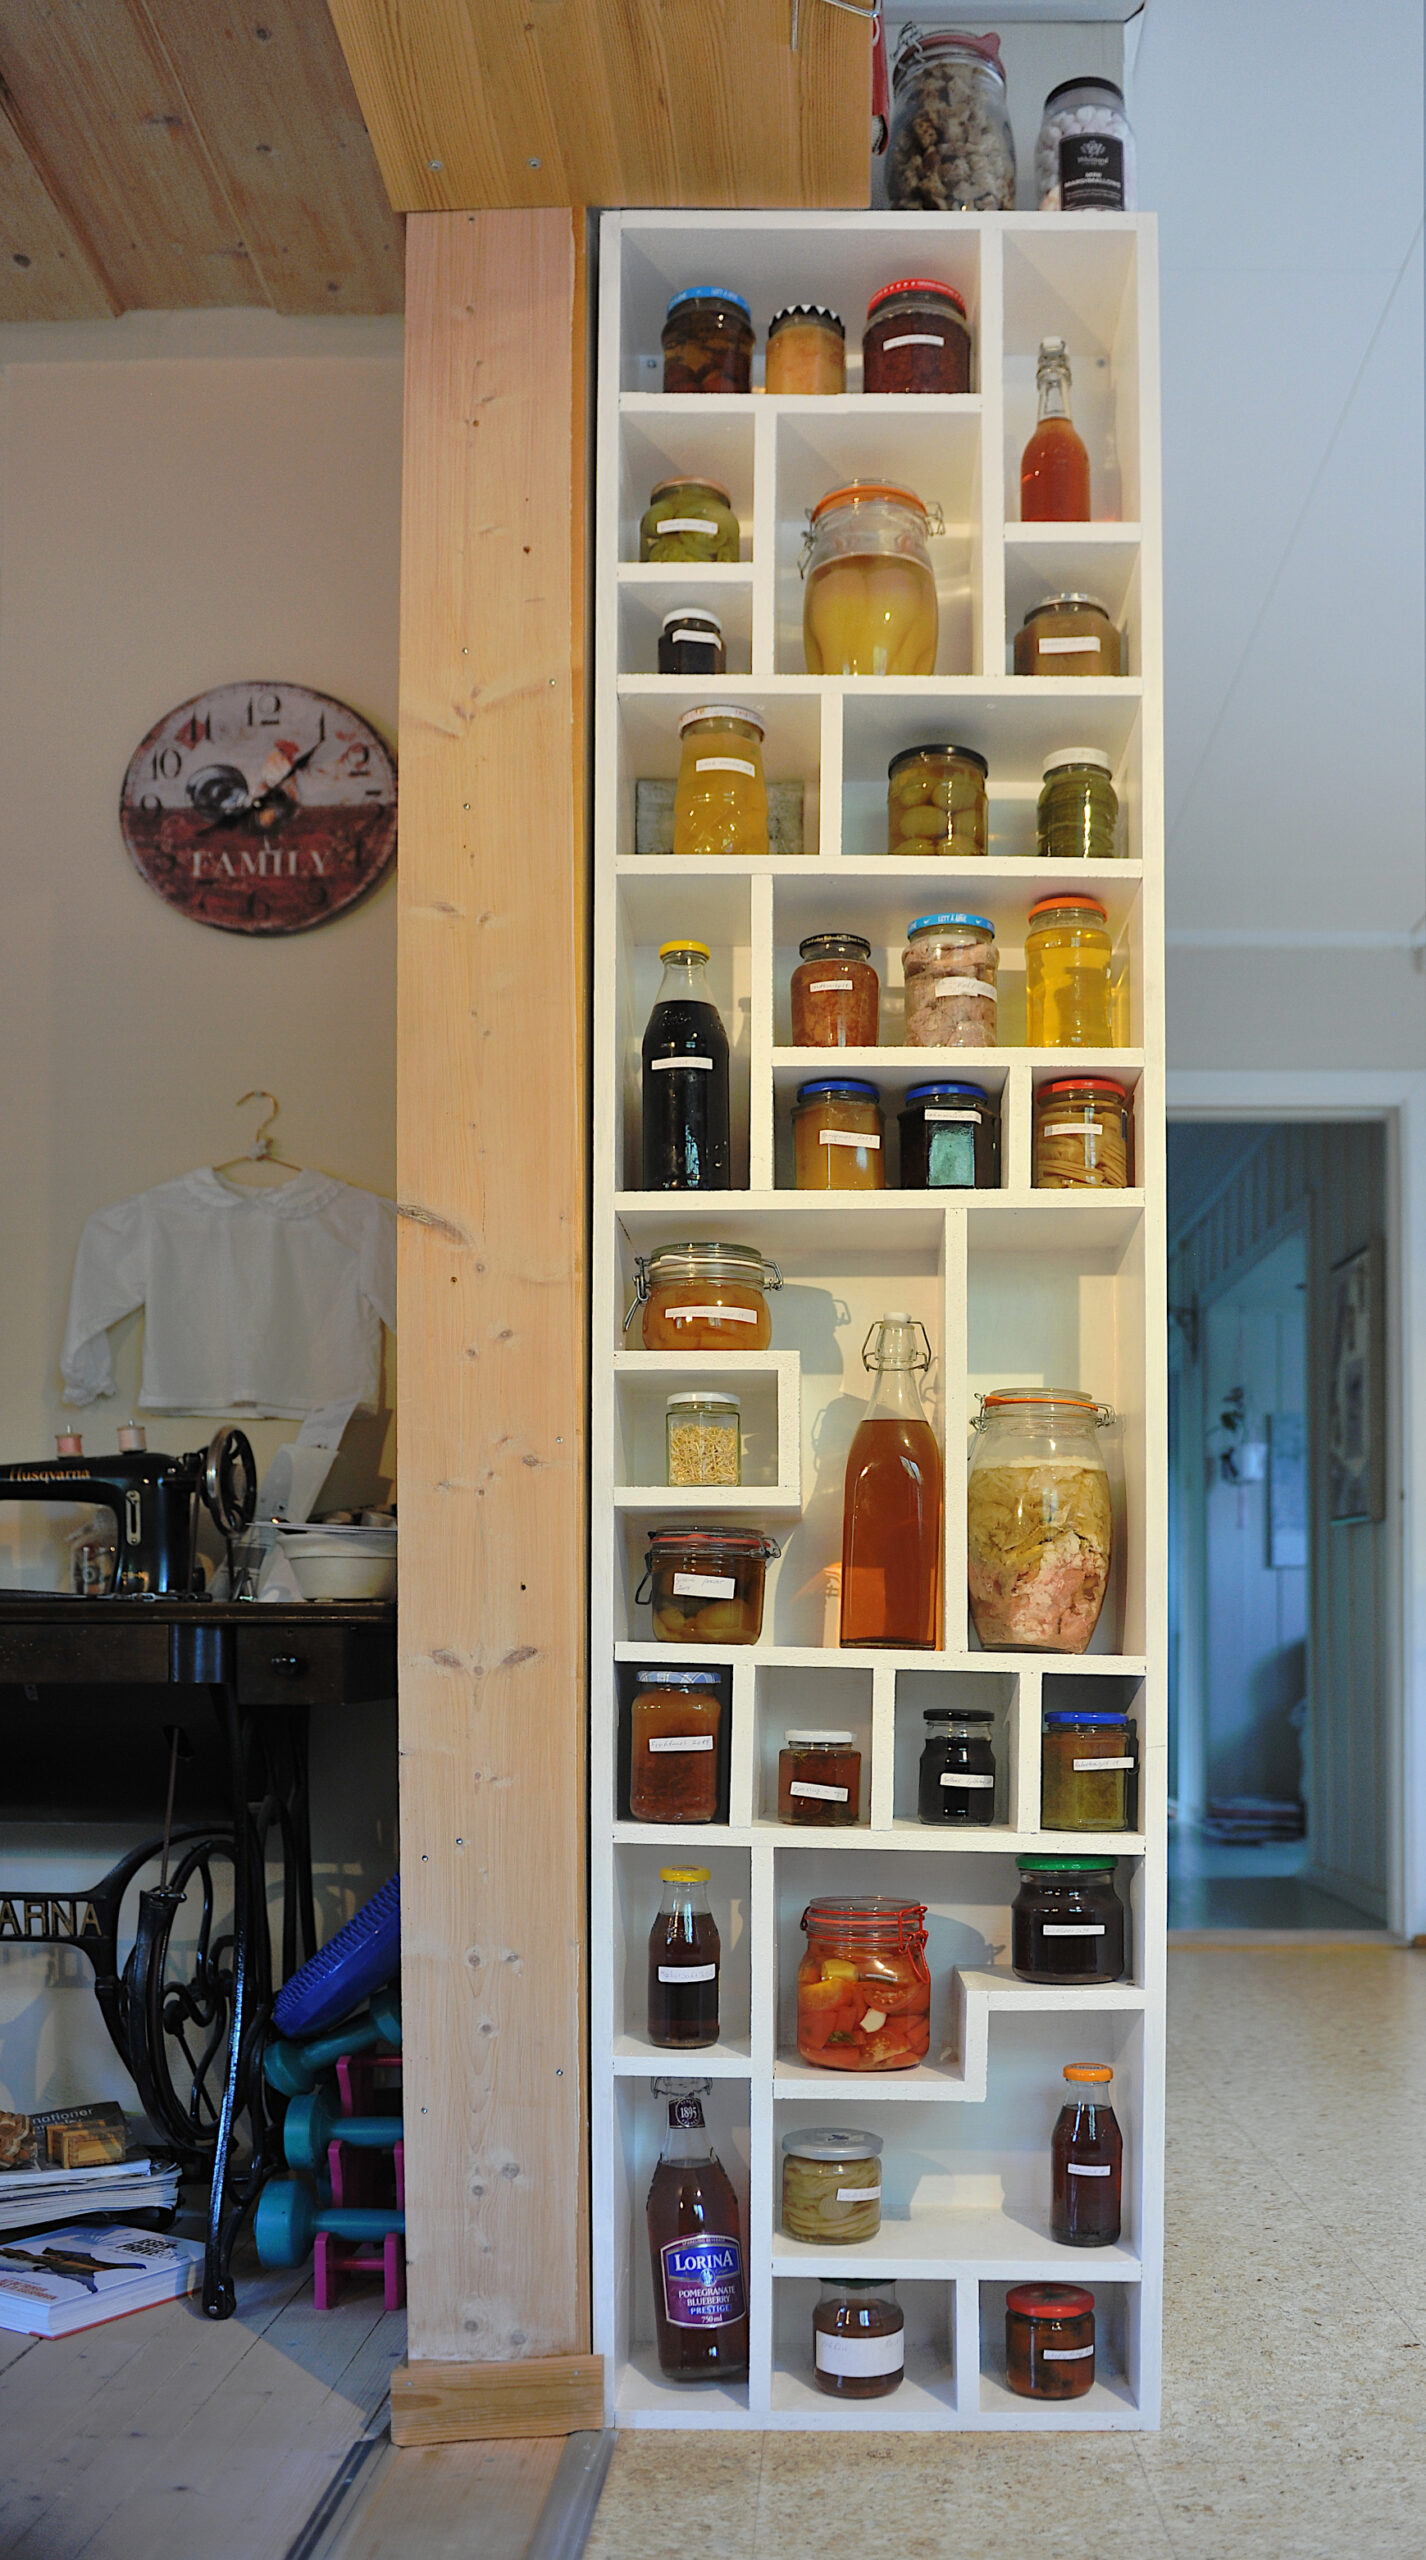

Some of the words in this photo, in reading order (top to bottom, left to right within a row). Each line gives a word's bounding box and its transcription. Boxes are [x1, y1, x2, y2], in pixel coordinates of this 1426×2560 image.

[247, 693, 281, 726] 12
[190, 710, 211, 741] 11
[319, 710, 326, 741] 1
[151, 748, 182, 781] 10
[347, 747, 371, 777] 2
[9, 1466, 91, 1484] Husqvarna
[680, 2106, 697, 2120] 1895
[674, 2249, 734, 2272] LORINA
[678, 2285, 736, 2299] POMEGRANATE
[687, 2295, 731, 2307] BLUEBERRY
[690, 2305, 730, 2315] PRESTIGE
[701, 2315, 713, 2324] 750
[713, 2314, 723, 2322] ml
